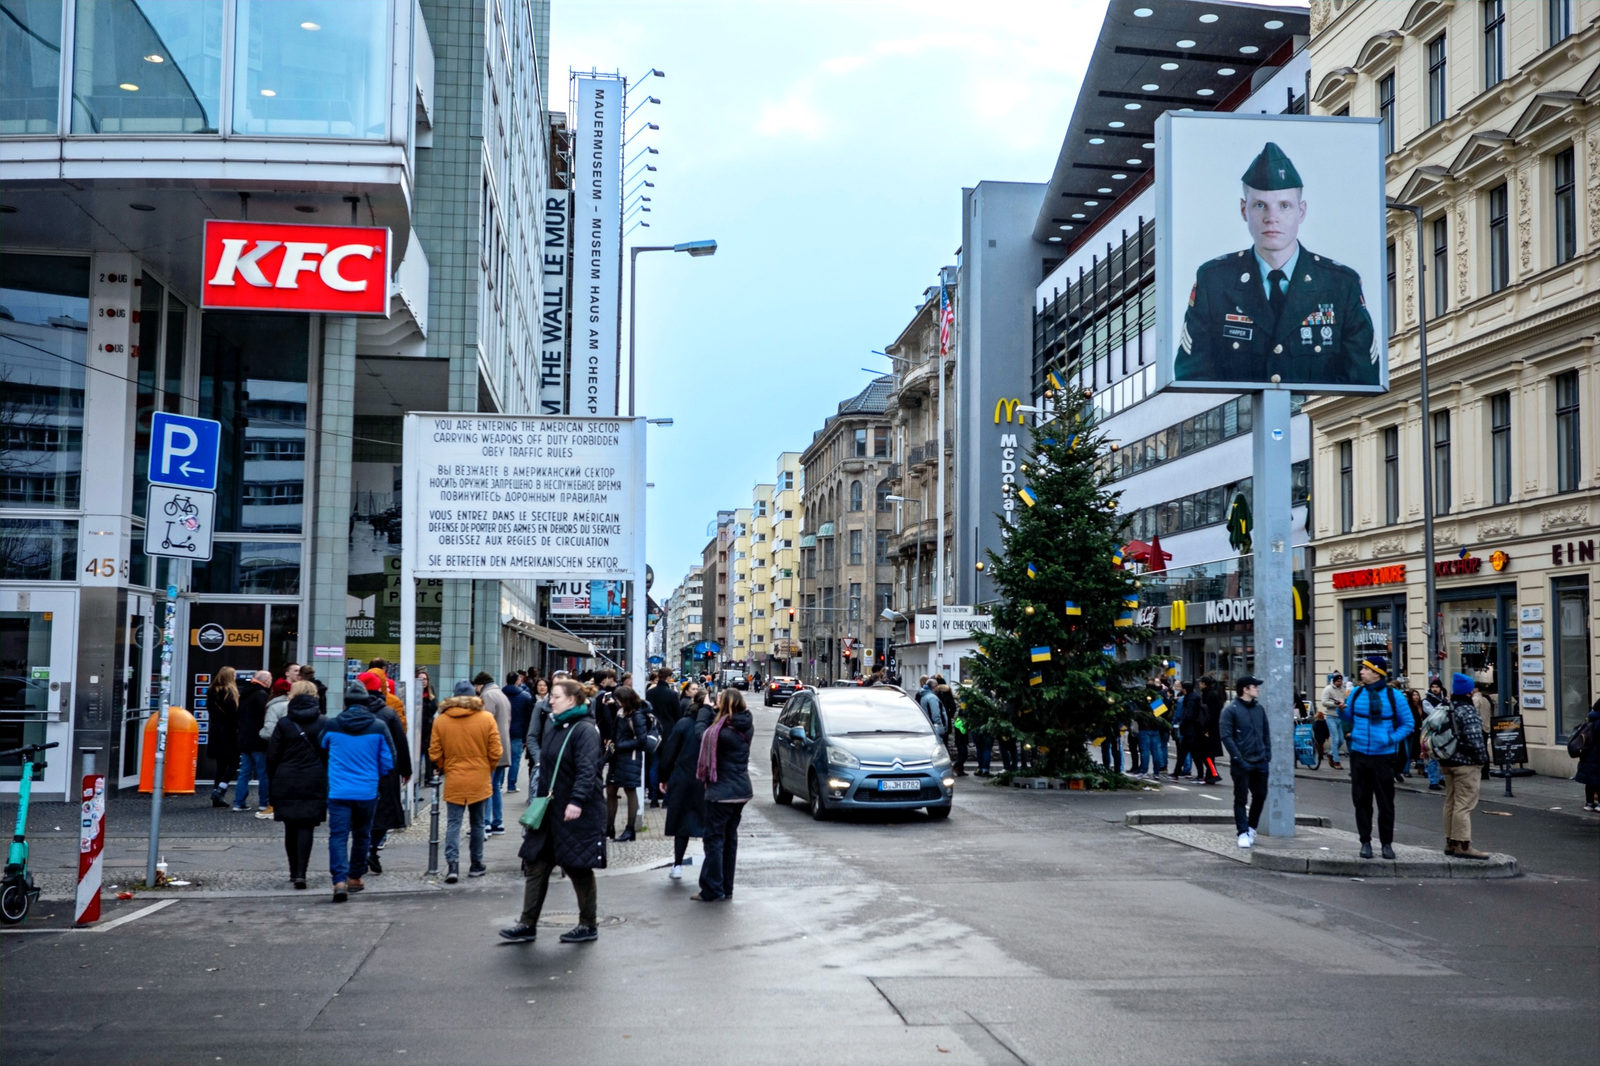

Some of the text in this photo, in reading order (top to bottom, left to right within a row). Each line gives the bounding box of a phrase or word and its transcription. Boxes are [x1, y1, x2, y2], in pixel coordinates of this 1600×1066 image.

[592, 89, 604, 200] MAUERMUSEUM
[545, 197, 566, 248] MUR
[591, 218, 602, 279] MUSEUM
[208, 238, 374, 292] KFC
[544, 254, 564, 275] LE
[100, 273, 128, 283] 2 UG
[590, 286, 600, 323] HAUS
[99, 308, 126, 318] 3 UG
[543, 287, 563, 344] WALL
[589, 330, 598, 350] AM
[98, 344, 124, 353] 4 UG
[541, 351, 561, 388] THE
[434, 420, 620, 433] YOU ARE ENTERING THE AMERICAN SECTOR
[433, 432, 619, 446] CARRYING WEAPONS OFF DUTY FORBIDDEN
[162, 422, 198, 474] P
[482, 446, 573, 458] OBEY TRAFFIC RULES
[438, 465, 615, 478] ВЫ ВЕЗЖАЕТЕ В АМЕРИКАНСКИЙ СЕКТОР
[429, 478, 457, 488] НОСИТЬ
[459, 478, 488, 489] ОРУЖИЕ
[536, 480, 541, 490] В
[597, 480, 621, 491] ВРЕМЯ
[505, 491, 555, 502] ДОРОЖНЫМ
[560, 492, 607, 503] ПРАВИЛАМ
[429, 510, 452, 520] VOUS
[457, 510, 488, 520] ENTREZ
[493, 511, 515, 521] DANS
[519, 511, 526, 521] LE
[532, 511, 568, 522] SECTEUR
[428, 522, 620, 535] DEFENSE DE PORTER DES ARMES EN DEHORS DU SERVICE
[439, 535, 609, 547] OBEISSEZ AUX REGLES DE CIRCULATION
[1552, 539, 1600, 566] EIN
[85, 558, 115, 577] 45
[428, 554, 618, 568] SIE BETRETEN DEN AMERIKANISCHEN SEKTOR
[920, 620, 930, 630] US
[953, 620, 990, 630] CHECKPOINT
[228, 633, 259, 642] CASH
